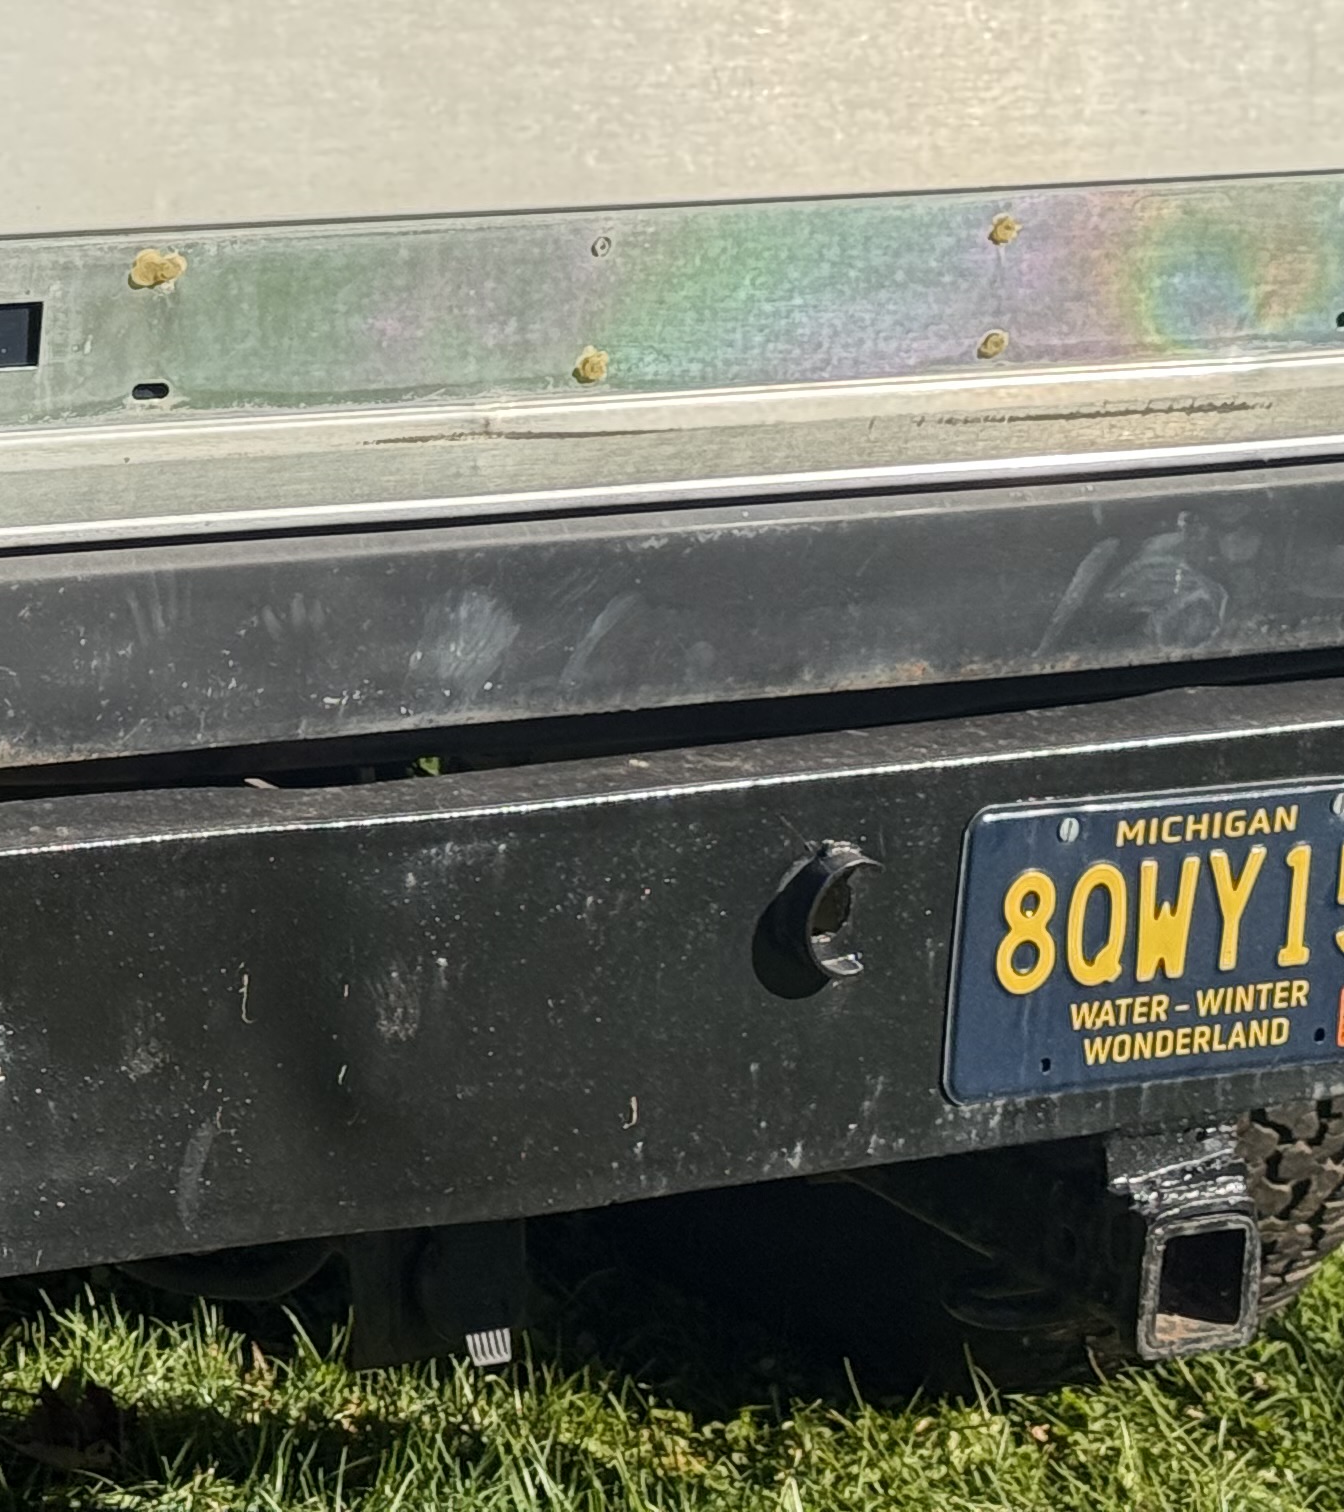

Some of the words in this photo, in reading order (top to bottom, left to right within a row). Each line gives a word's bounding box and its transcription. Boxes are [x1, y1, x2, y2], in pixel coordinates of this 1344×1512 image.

[1116, 805, 1299, 848] MICHIGAN
[995, 843, 1344, 995] 8QWY1
[1083, 1017, 1290, 1066] WONDERLAND
